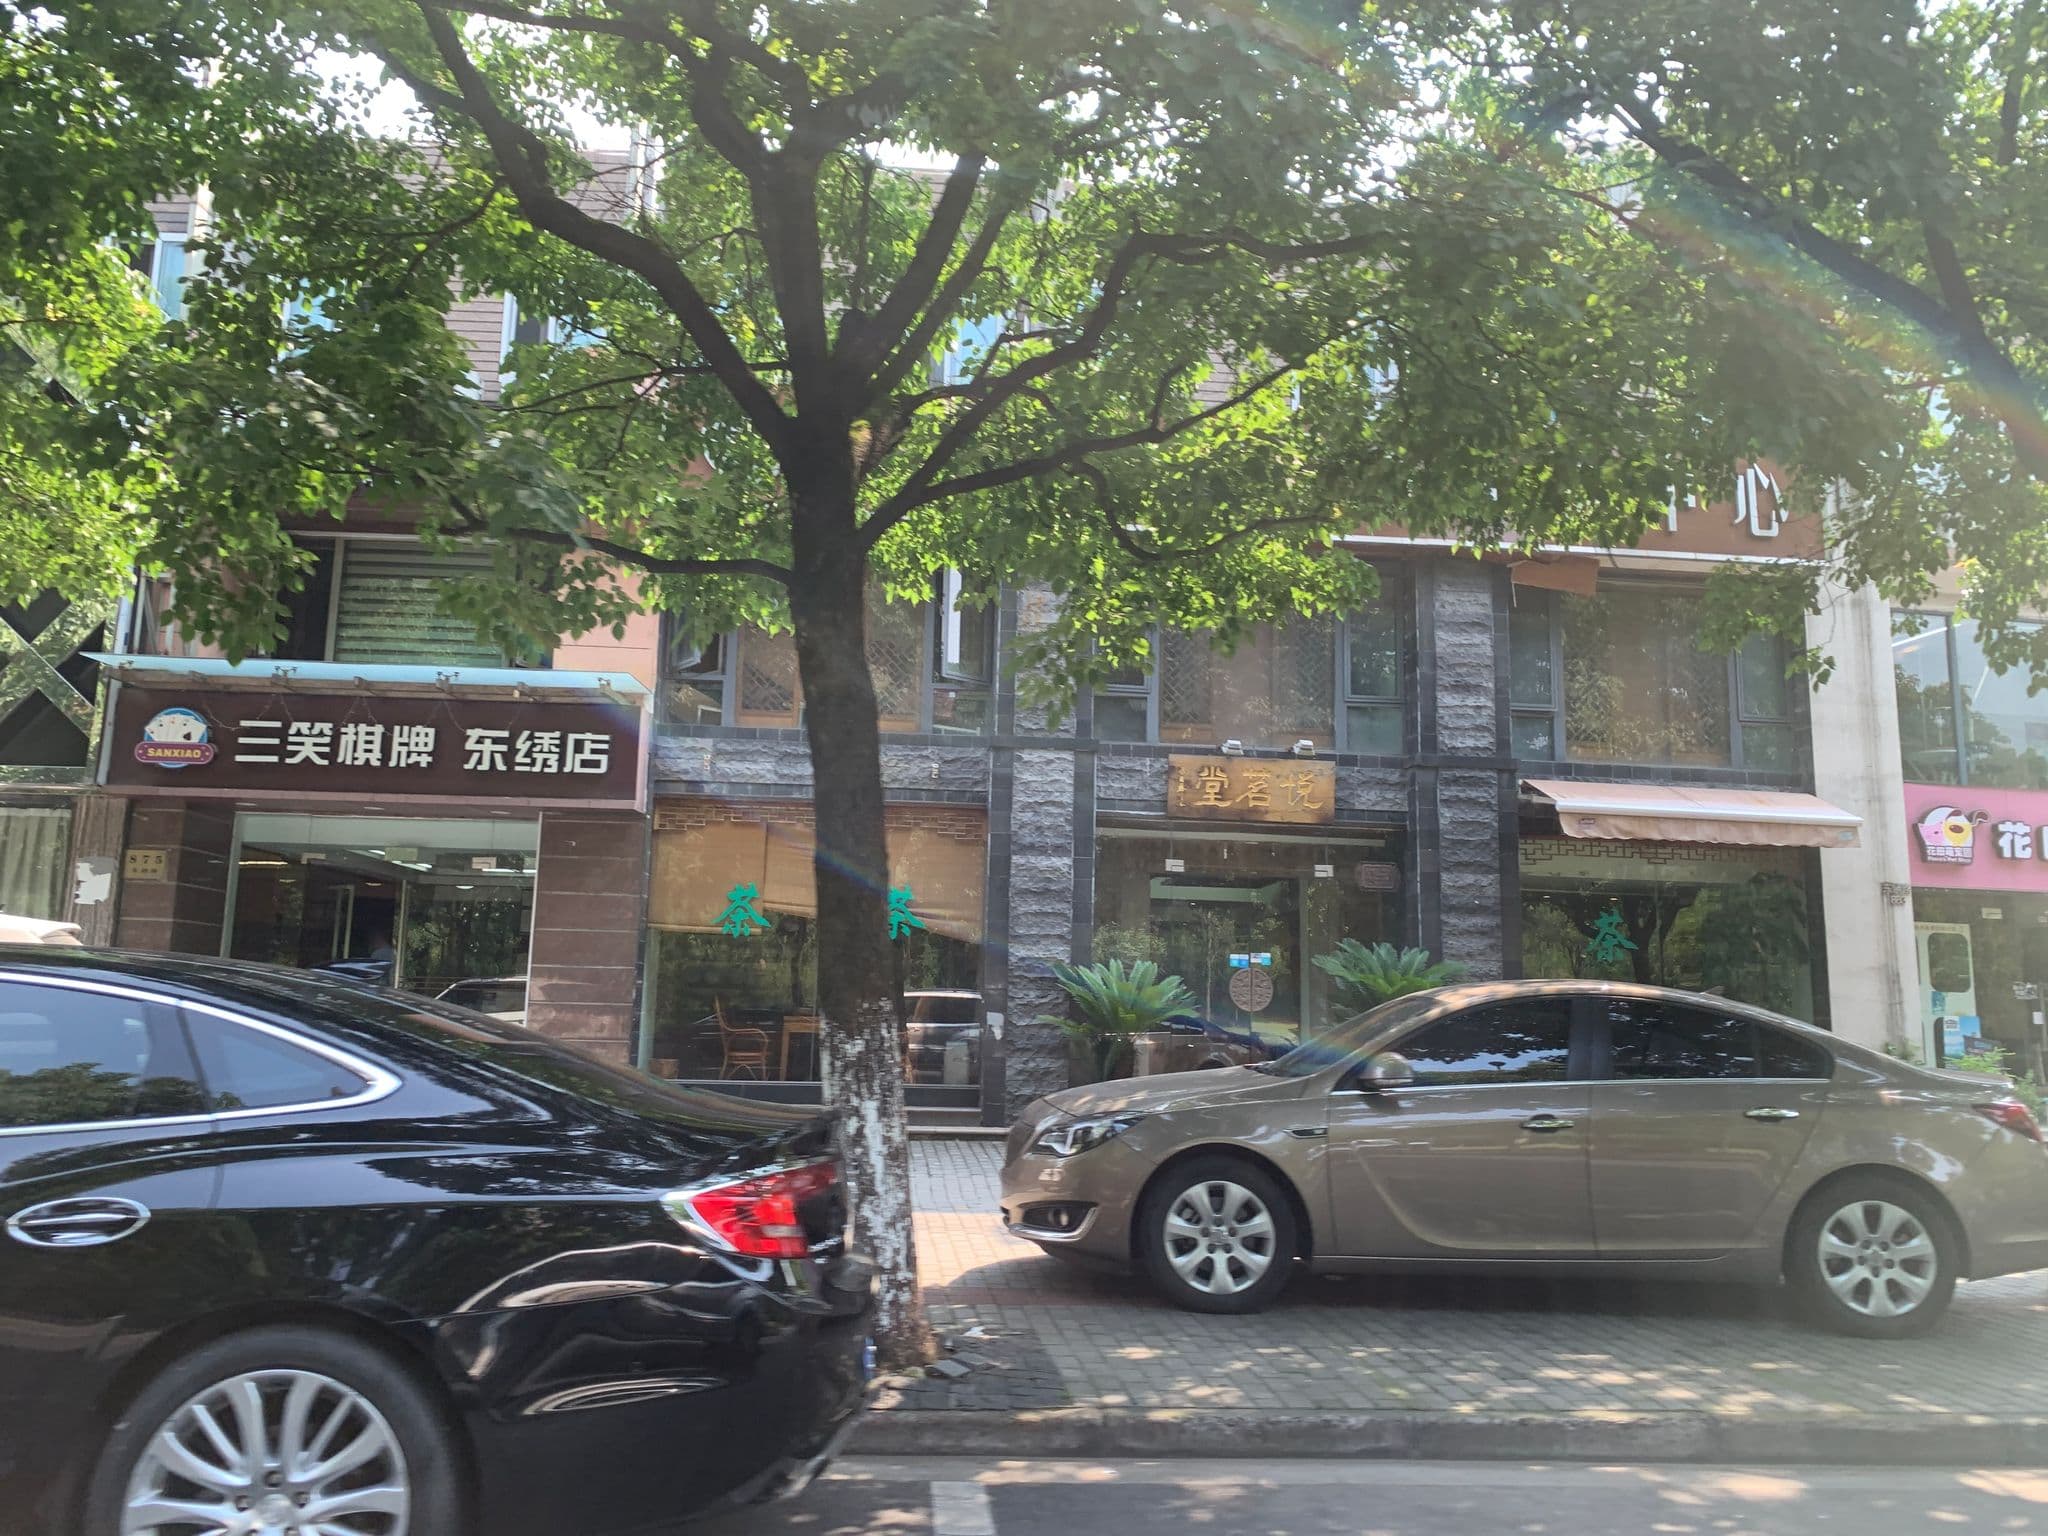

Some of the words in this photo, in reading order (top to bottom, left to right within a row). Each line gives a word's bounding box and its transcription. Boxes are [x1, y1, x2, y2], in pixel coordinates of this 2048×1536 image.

[146, 747, 202, 759] SANXIAO
[234, 719, 436, 769] 三笑棋牌
[463, 727, 611, 775] 东绣店
[711, 881, 772, 939] 茶
[1584, 907, 1639, 963] 茶
